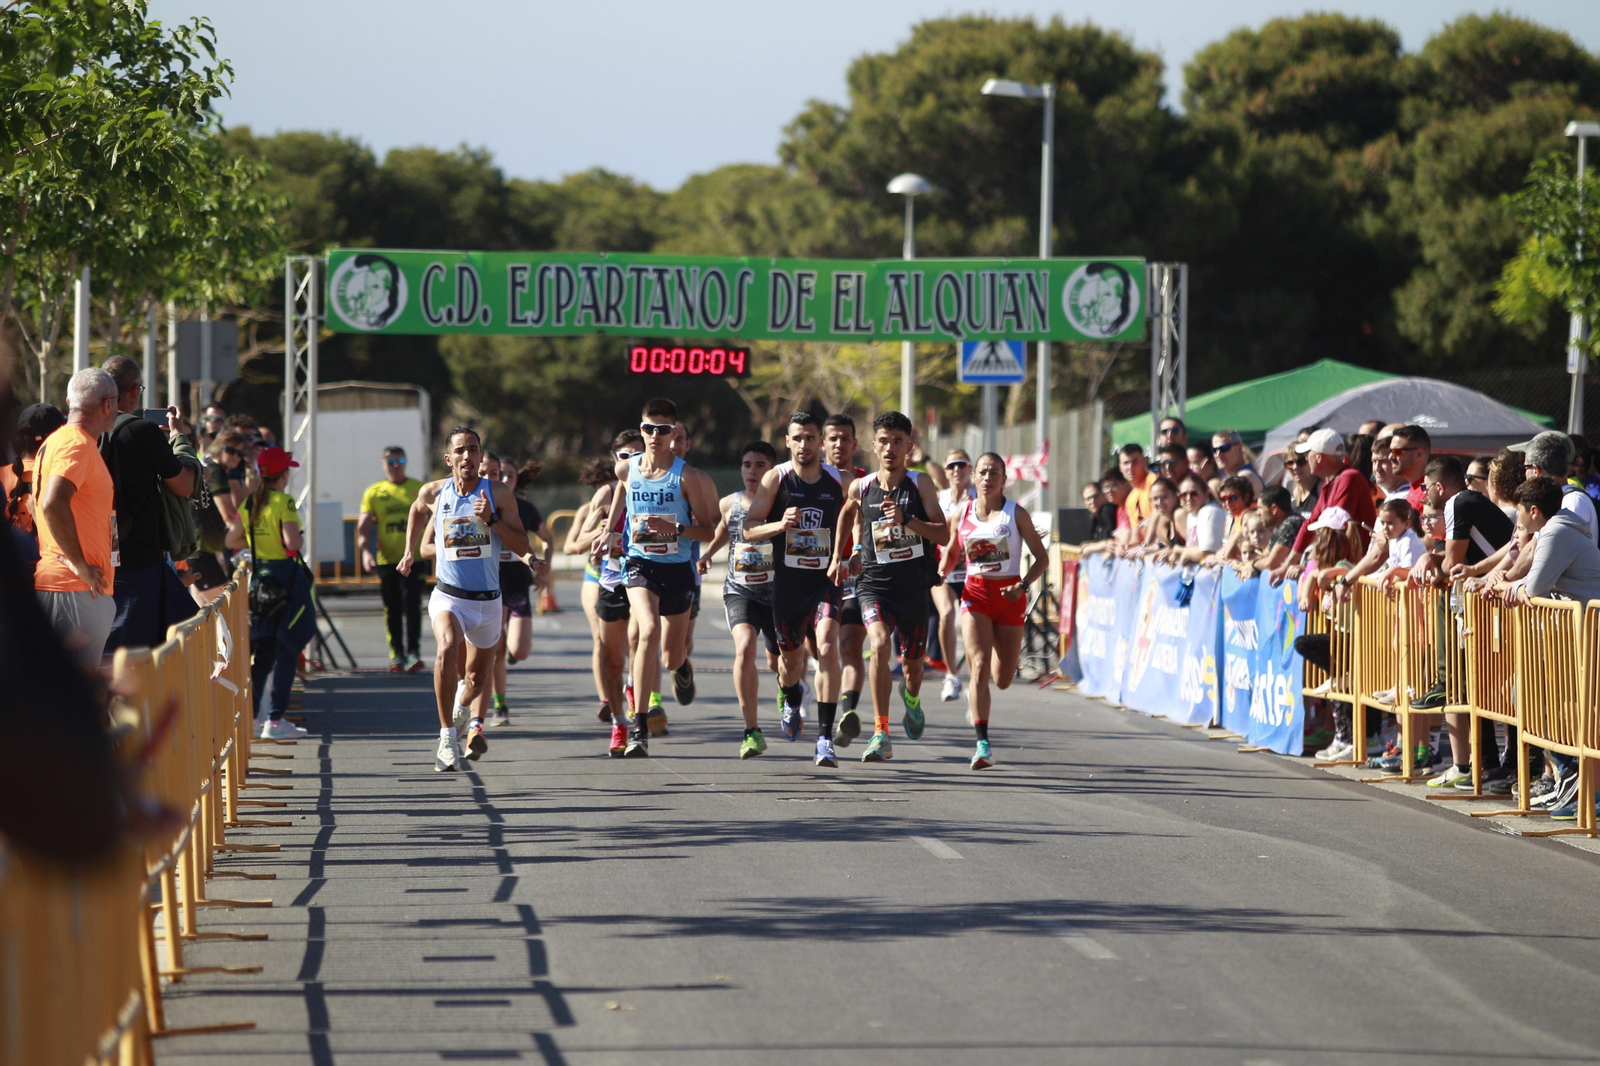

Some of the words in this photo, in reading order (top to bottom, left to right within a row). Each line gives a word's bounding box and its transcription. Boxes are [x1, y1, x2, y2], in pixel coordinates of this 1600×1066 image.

[421, 262, 492, 326] C.D.
[508, 263, 755, 332] ESPARTANOS
[767, 269, 818, 333] DE
[830, 271, 875, 334] EL
[881, 268, 1051, 340] ALQUIAN
[630, 346, 747, 375] 00:00:04
[632, 488, 675, 505] nerja
[448, 522, 478, 538] 204
[882, 526, 903, 542] 19
[791, 534, 820, 548] 200
[739, 551, 765, 565] 205
